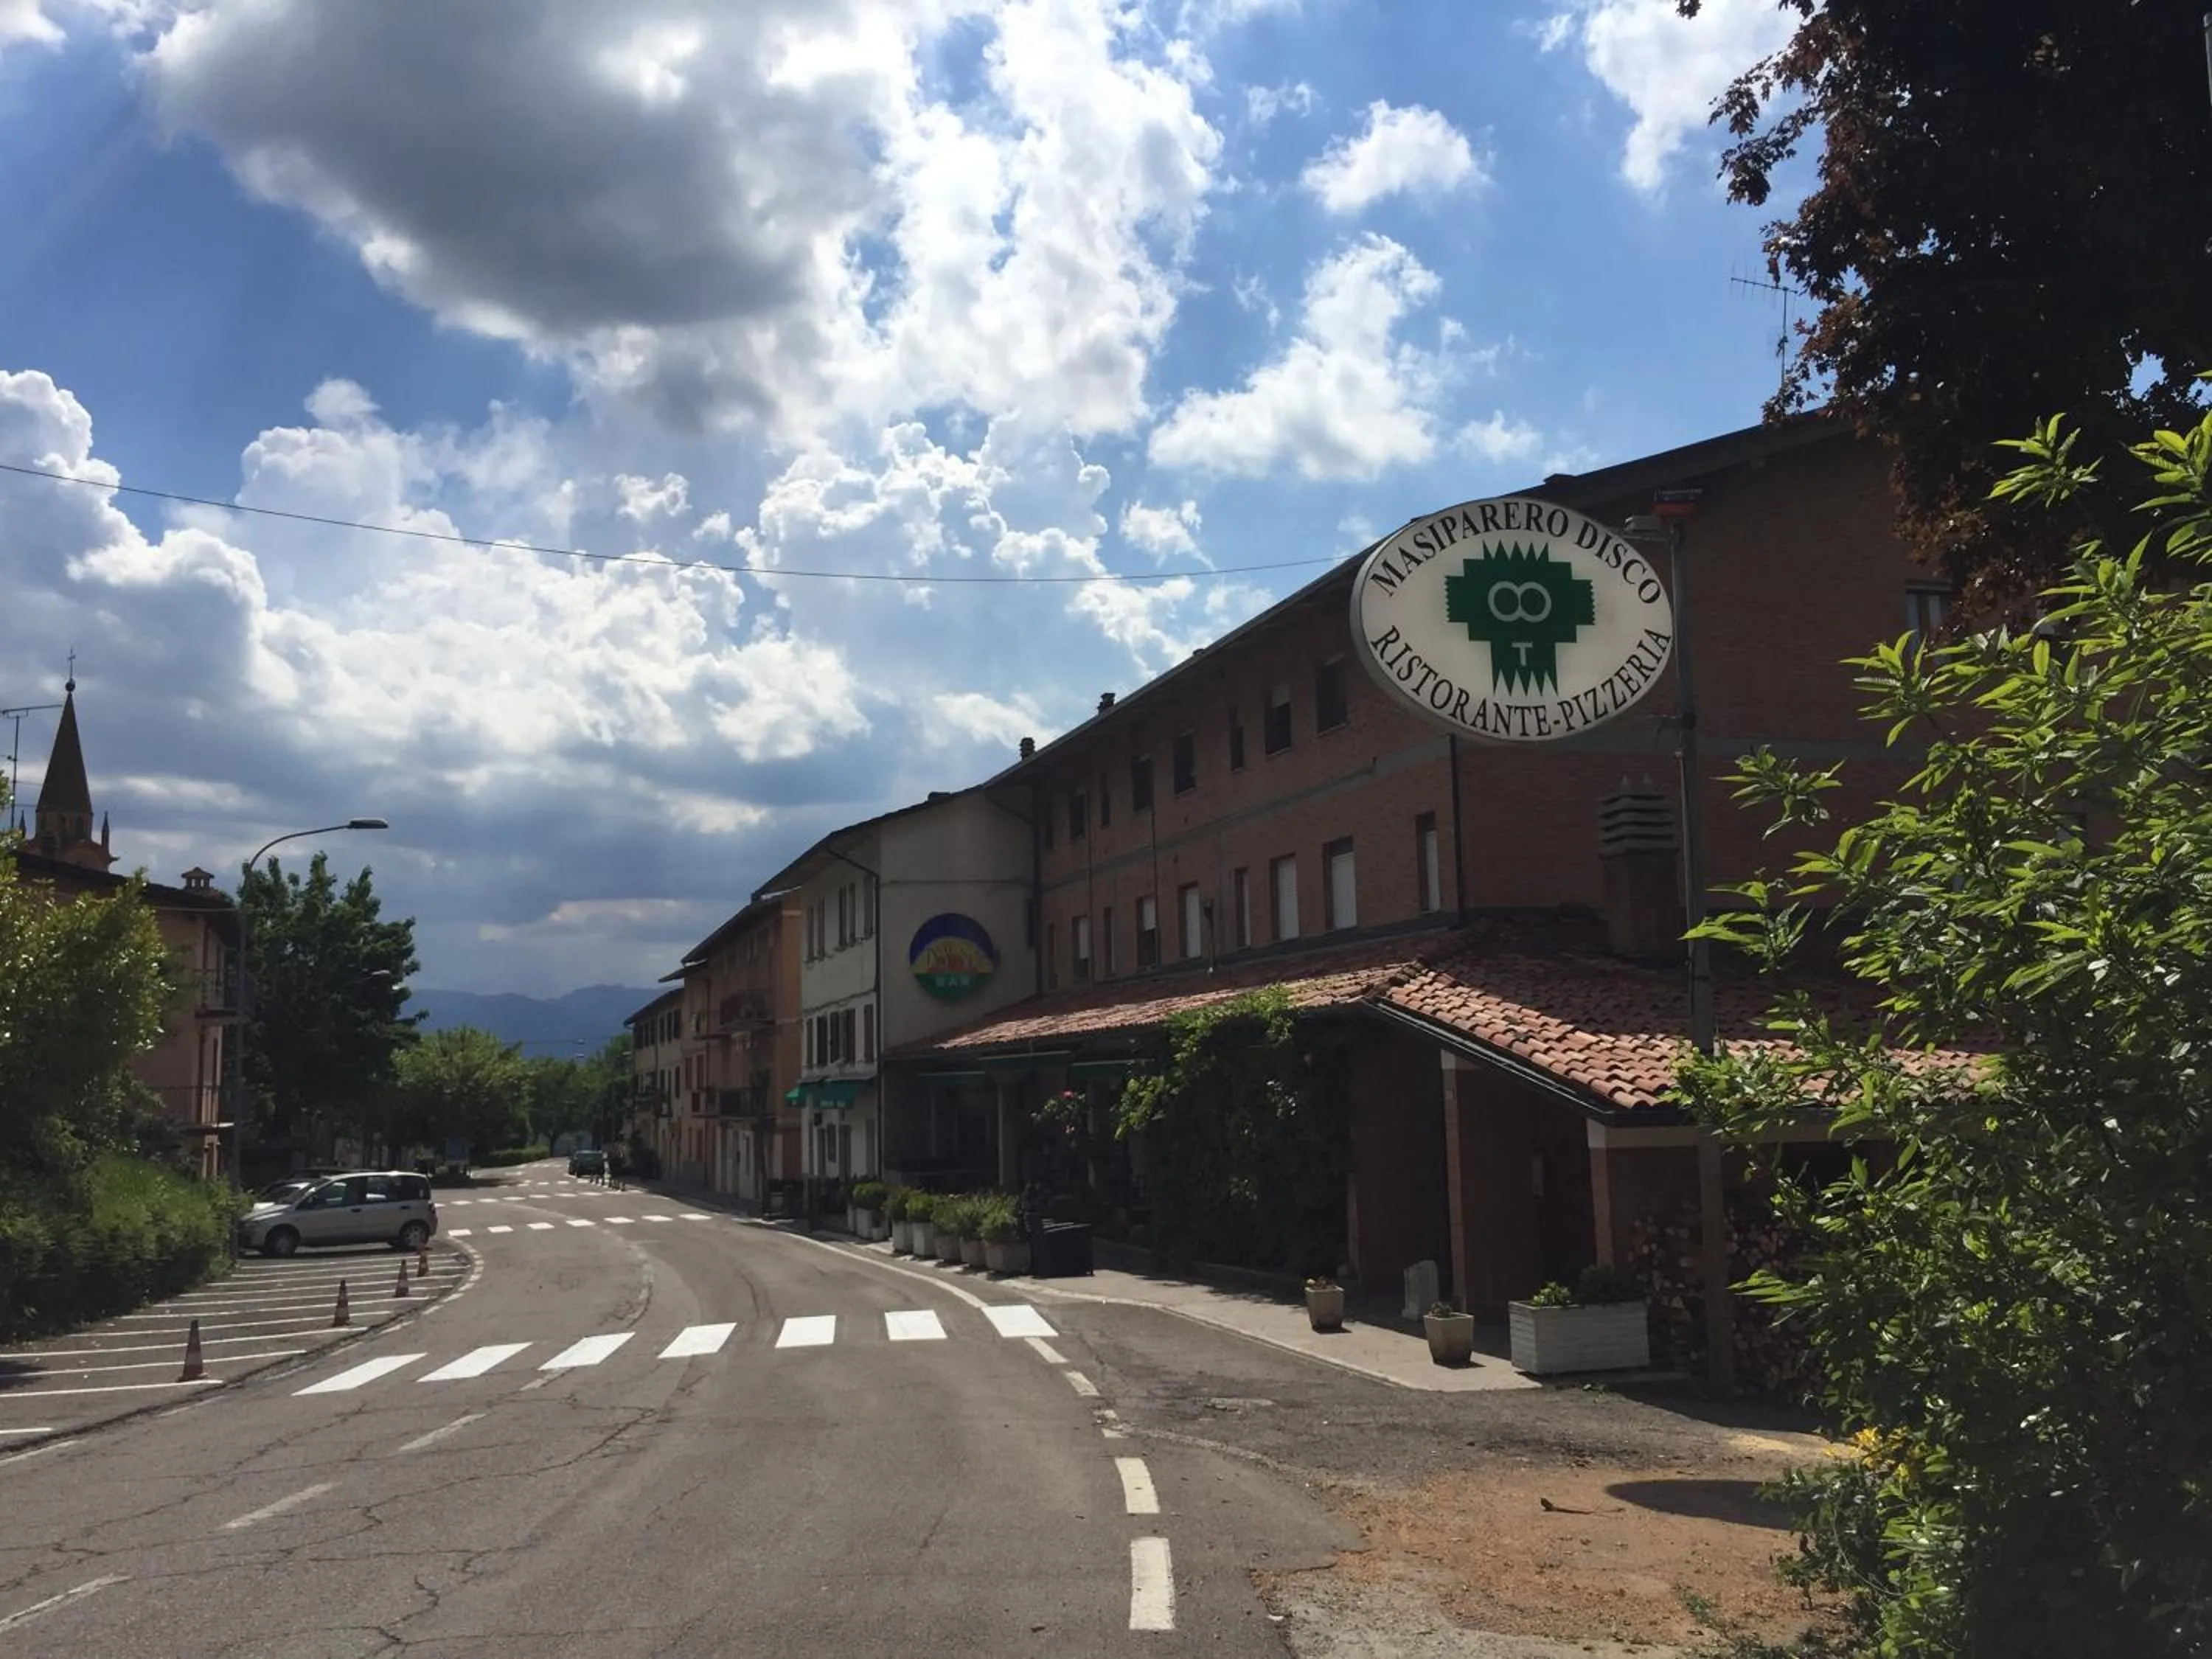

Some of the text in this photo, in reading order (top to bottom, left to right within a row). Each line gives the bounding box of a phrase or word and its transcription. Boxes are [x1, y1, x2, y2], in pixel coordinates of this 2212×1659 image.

[1369, 501, 1662, 605] MASIPARERO DISCO
[1371, 625, 1672, 737] RISTORANTE-PIZZERIA
